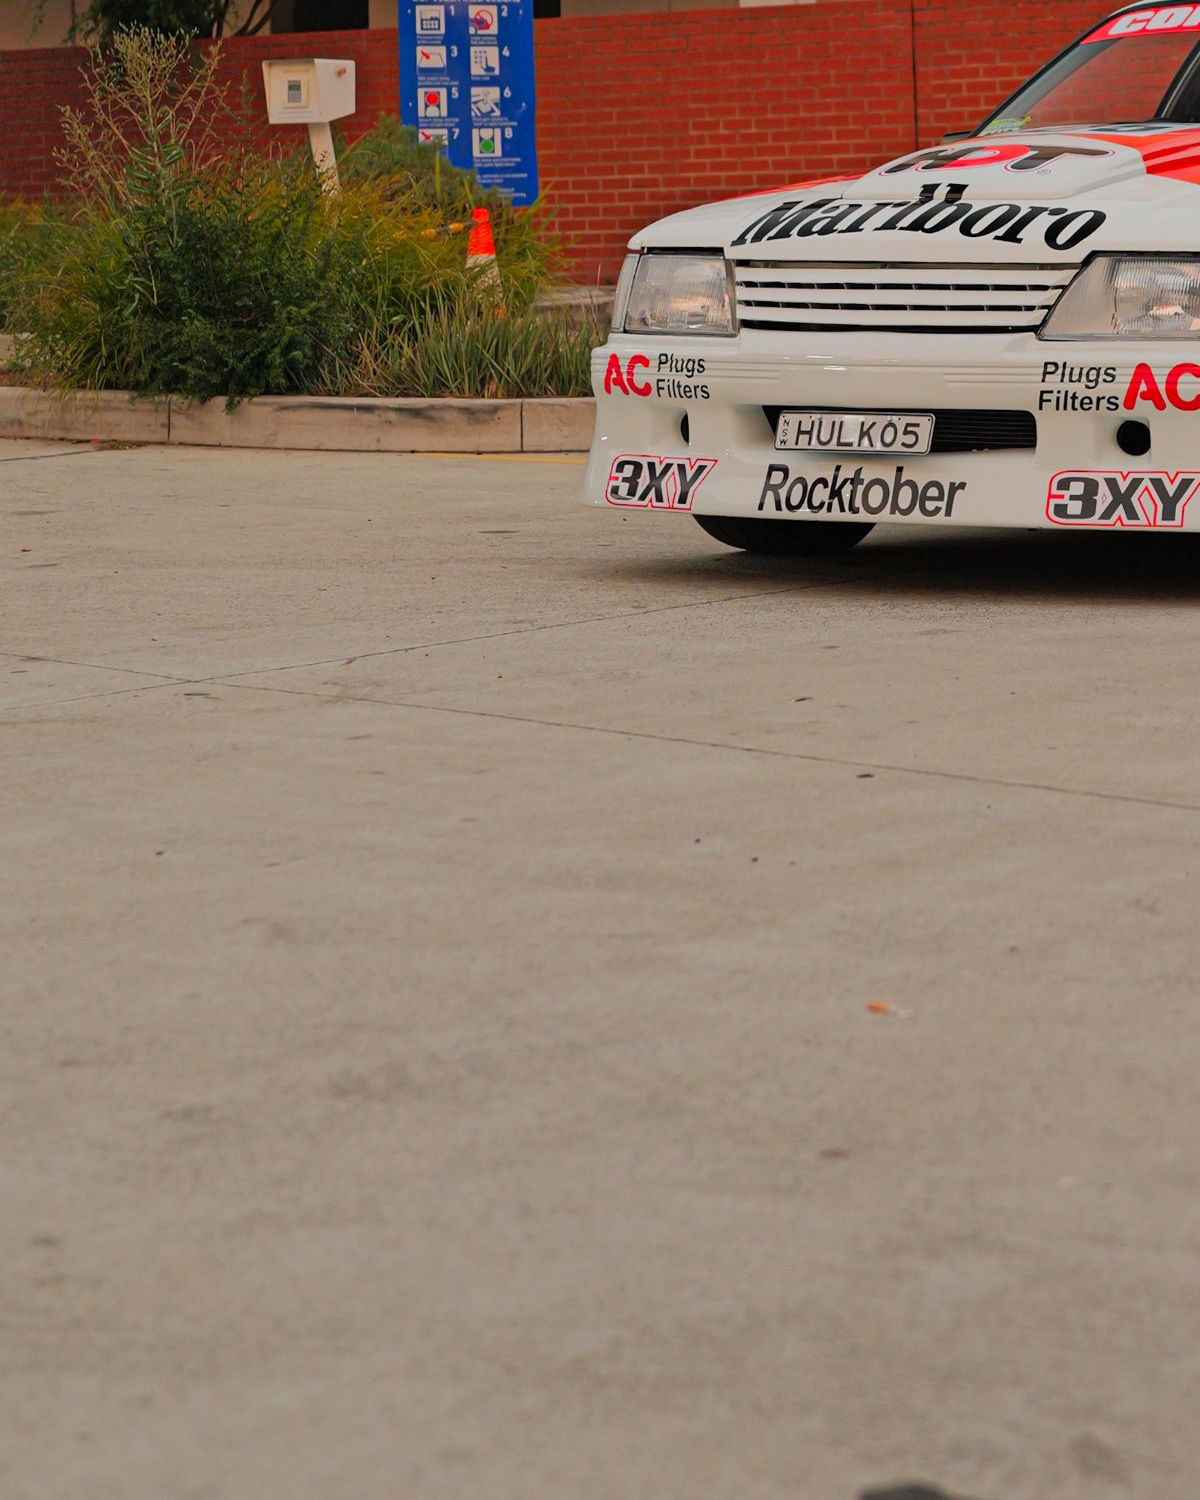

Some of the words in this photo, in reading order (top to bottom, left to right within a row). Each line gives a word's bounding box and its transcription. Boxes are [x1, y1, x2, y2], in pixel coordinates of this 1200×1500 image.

[449, 5, 456, 16] 1
[501, 5, 508, 17] 2
[450, 45, 458, 57] 3
[502, 46, 510, 57] 4
[451, 87, 459, 99] 5
[504, 86, 511, 98] 6
[452, 128, 460, 140] 7
[505, 127, 513, 139] 8
[730, 183, 1107, 251] Marlboro
[657, 353, 706, 378] Plugs
[604, 353, 652, 397] AC
[1041, 361, 1117, 389] Plugs
[656, 379, 710, 399] Filters
[1038, 390, 1120, 411] Filters
[608, 457, 712, 507] 3XY
[757, 463, 967, 517] Rocktober
